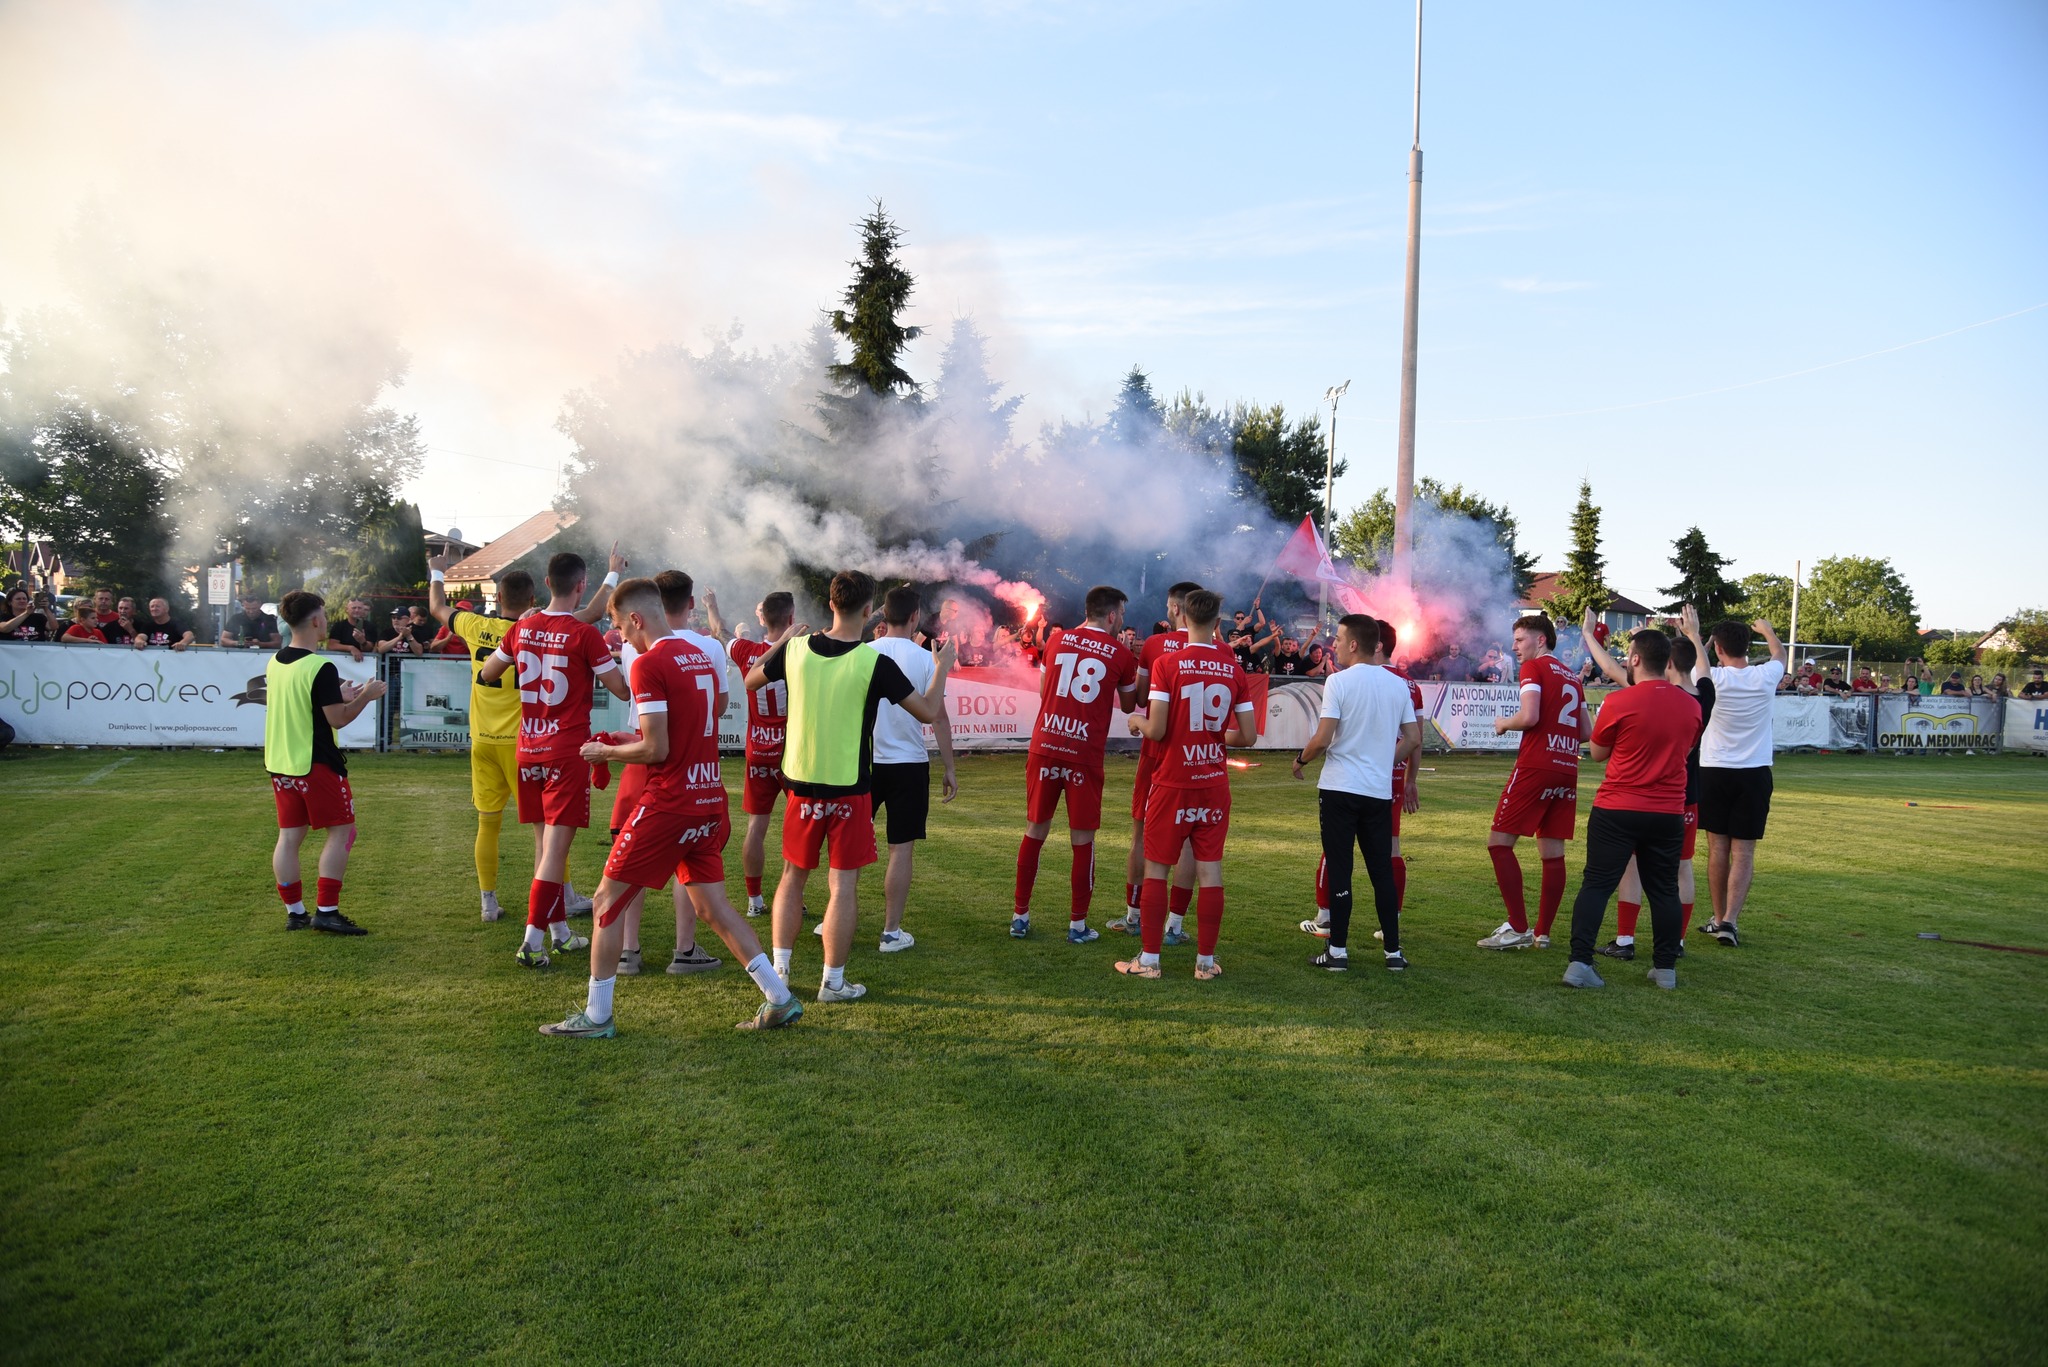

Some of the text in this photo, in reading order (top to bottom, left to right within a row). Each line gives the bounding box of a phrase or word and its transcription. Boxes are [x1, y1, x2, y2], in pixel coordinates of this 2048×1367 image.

[479, 631, 493, 642] NK
[535, 631, 570, 643] POLET
[1062, 633, 1117, 655] NK POLET
[1163, 639, 1179, 649] NK
[673, 654, 692, 666] NK
[1178, 660, 1235, 674] NK POLET
[516, 650, 569, 707] 25
[1054, 653, 1107, 704] 18
[756, 679, 787, 717] 11
[1451, 688, 1520, 702] NAVODNJAVAN
[694, 674, 714, 737] 7
[957, 696, 1017, 716] BOYS
[1181, 681, 1232, 732] 19
[1451, 704, 1497, 717] SPORTSKIH
[1557, 683, 1579, 728] 2
[108, 723, 238, 733] Dunjkovec www.poljoposavec.com
[973, 725, 987, 734] NA
[990, 724, 1017, 733] MURI
[1044, 712, 1089, 737] VNUK
[412, 730, 463, 743] NAMJEŠTAJ
[1880, 734, 1924, 747] OPTIKA
[1182, 743, 1225, 760] VNUK
